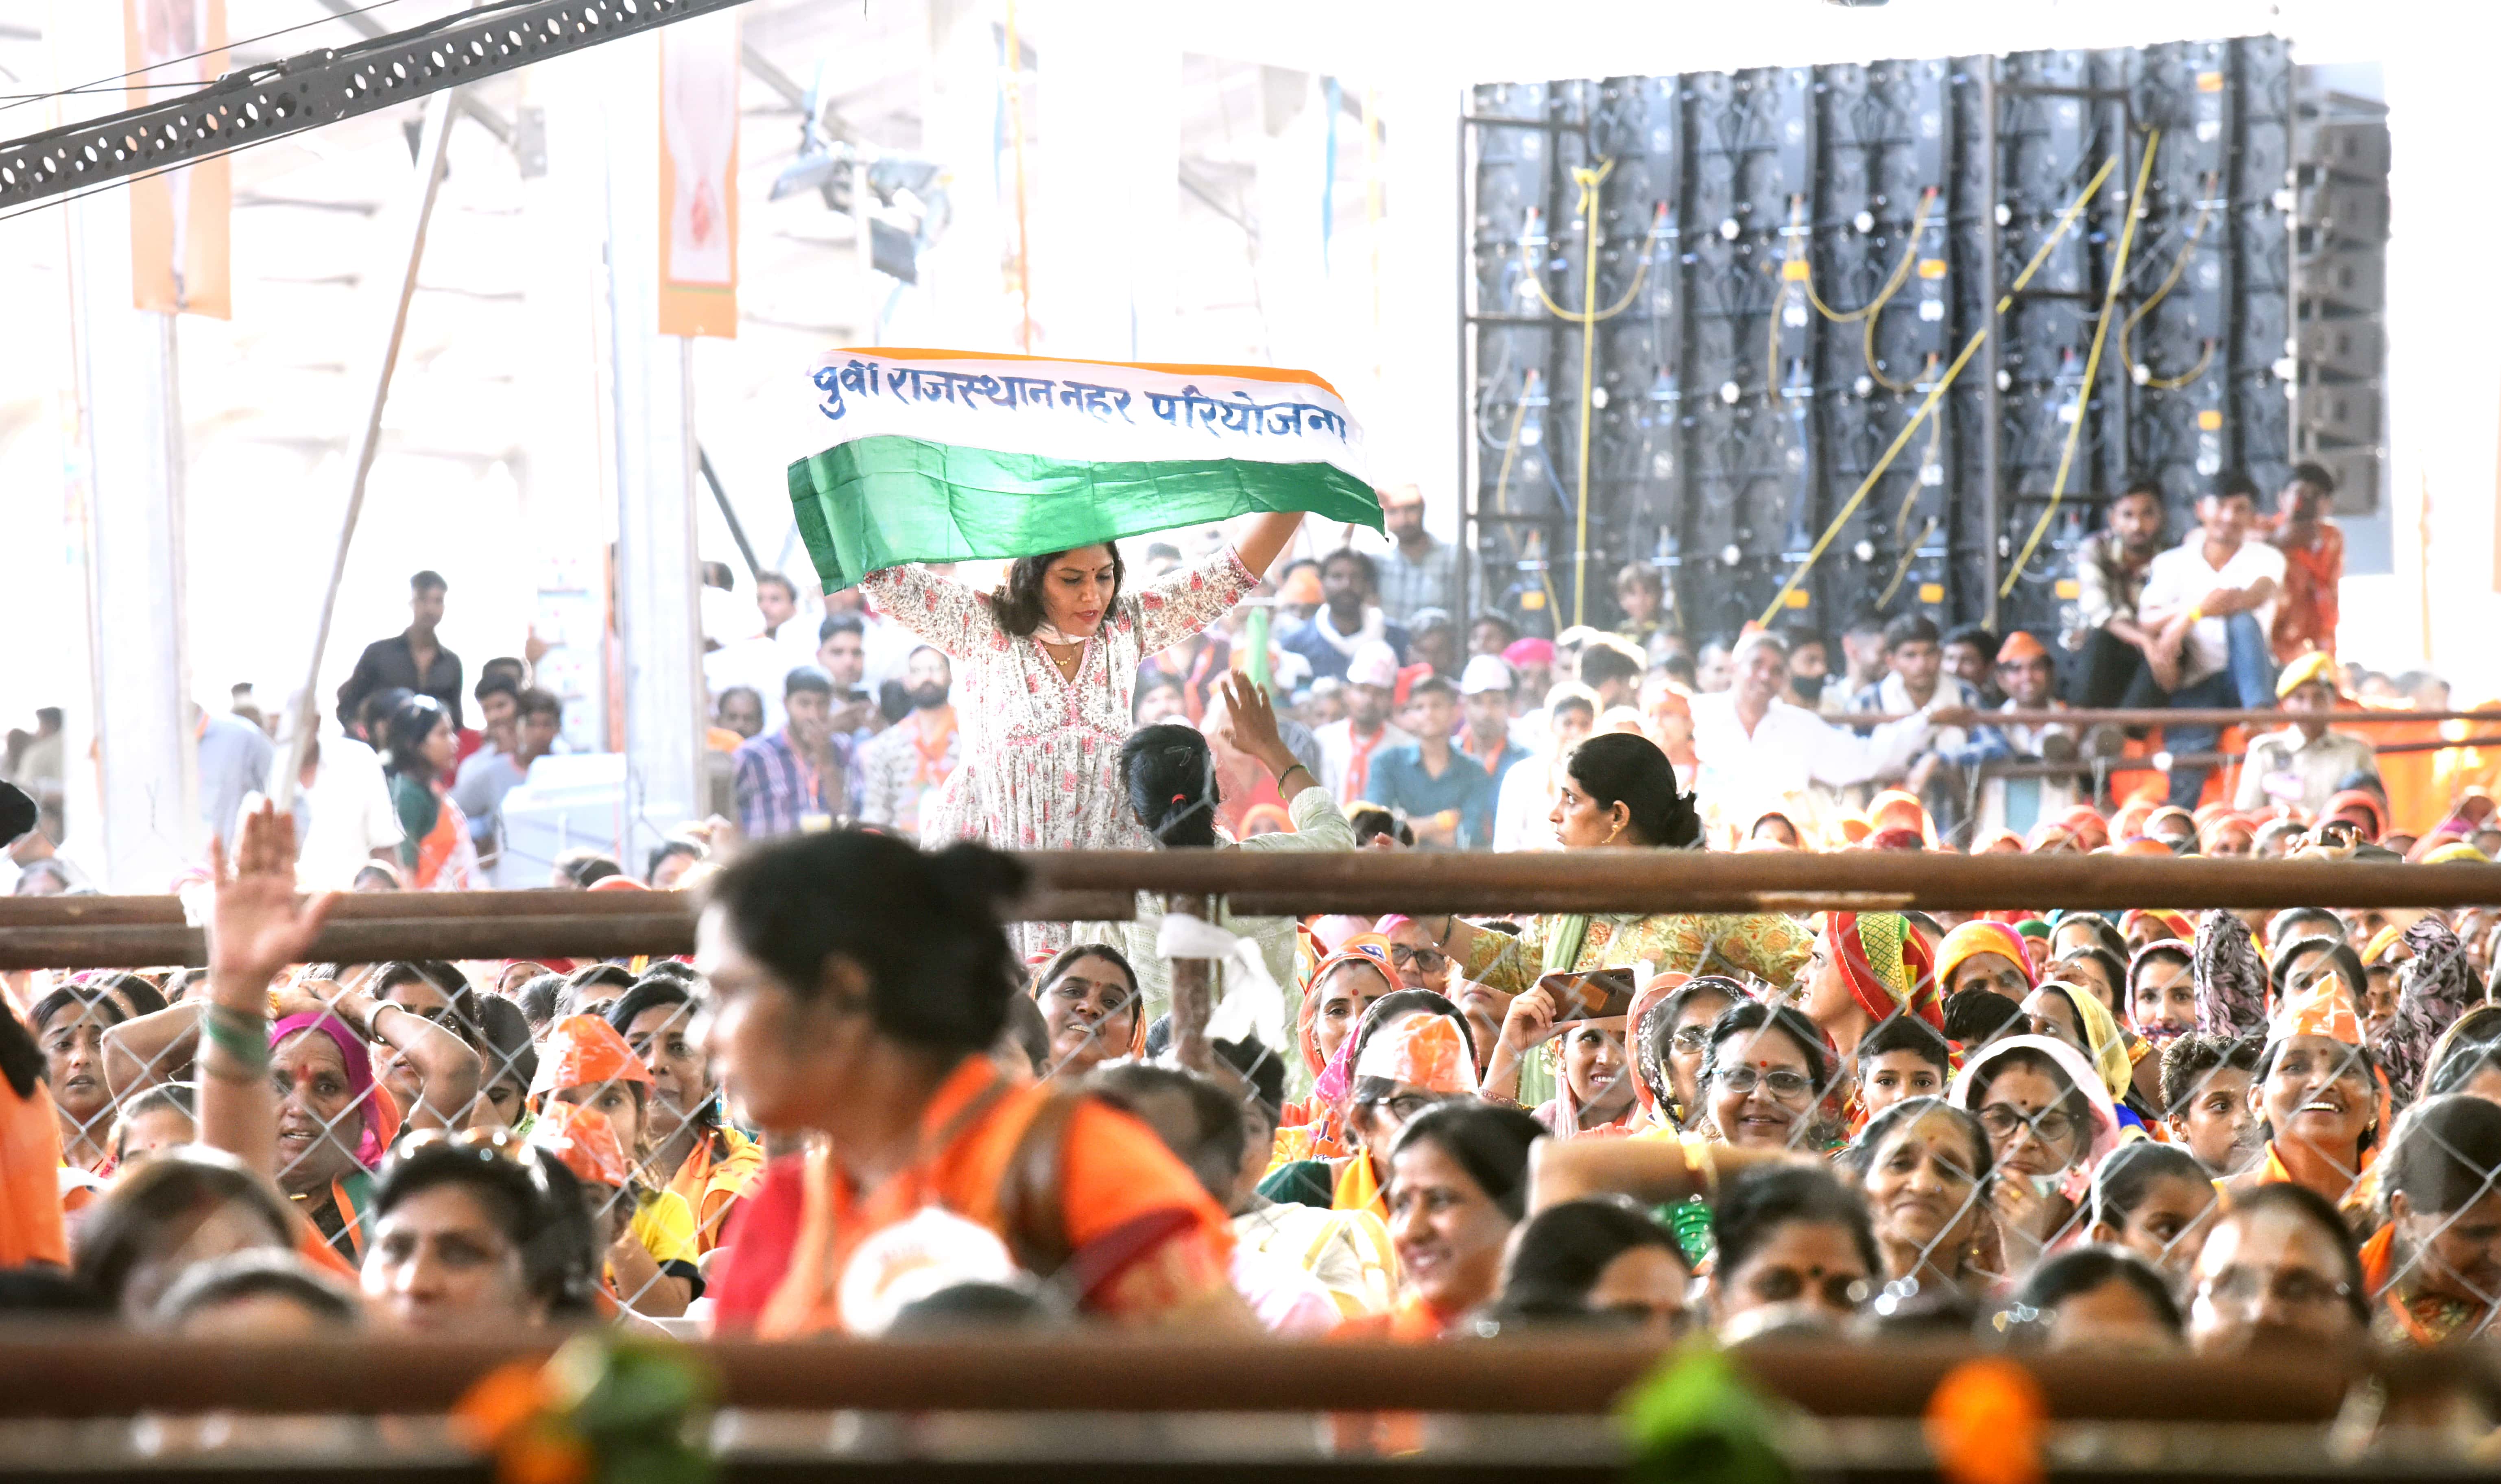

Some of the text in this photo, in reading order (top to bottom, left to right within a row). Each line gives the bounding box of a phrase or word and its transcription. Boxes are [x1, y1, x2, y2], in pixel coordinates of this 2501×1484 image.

[887, 368, 1056, 411] राजस्थान
[1060, 381, 1136, 425] नहर
[1144, 385, 1347, 445] परियोजना
